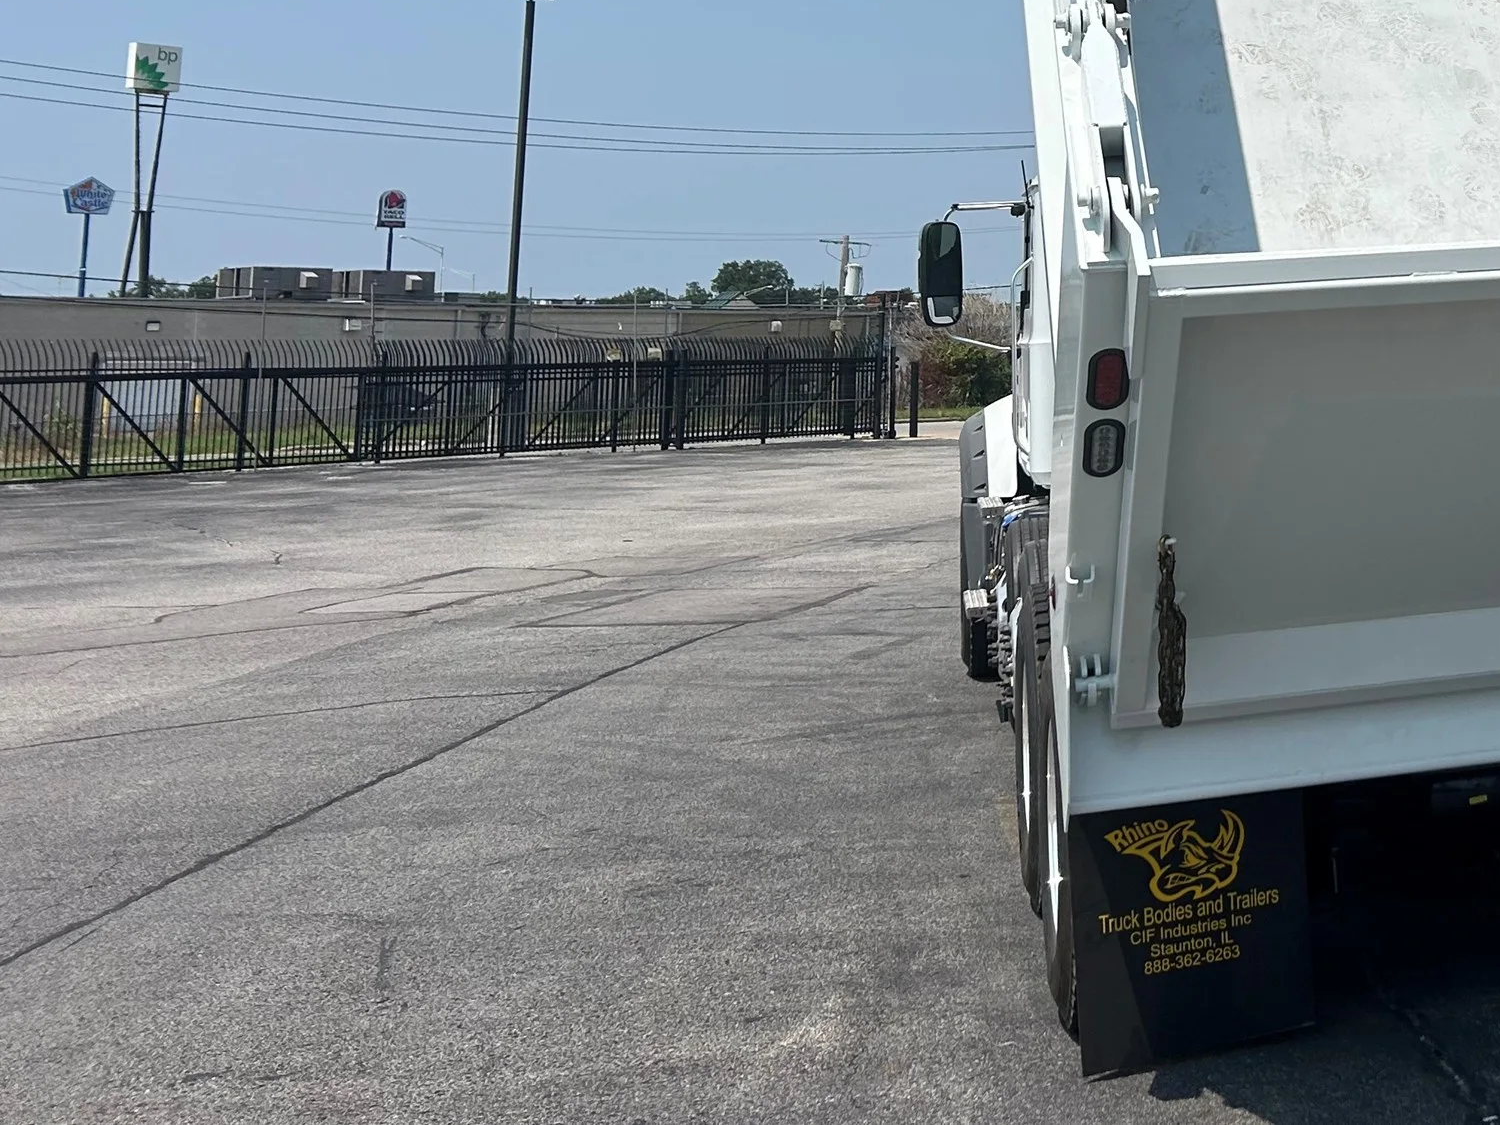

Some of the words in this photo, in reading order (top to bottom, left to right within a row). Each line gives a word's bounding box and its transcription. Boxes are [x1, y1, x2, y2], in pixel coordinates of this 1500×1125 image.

[158, 47, 178, 65] bp
[1104, 819, 1169, 852] Rhino
[1099, 909, 1140, 934] Truck
[1144, 903, 1193, 926] Bodies
[1197, 897, 1224, 915] and
[1227, 887, 1280, 910] Trailers
[1130, 928, 1157, 945] CIF
[1160, 917, 1227, 940] Industries
[1231, 912, 1252, 927] Inc
[1150, 935, 1217, 958] Staunton,
[1221, 930, 1234, 944] IL
[1144, 944, 1241, 975] 888-362-6263
